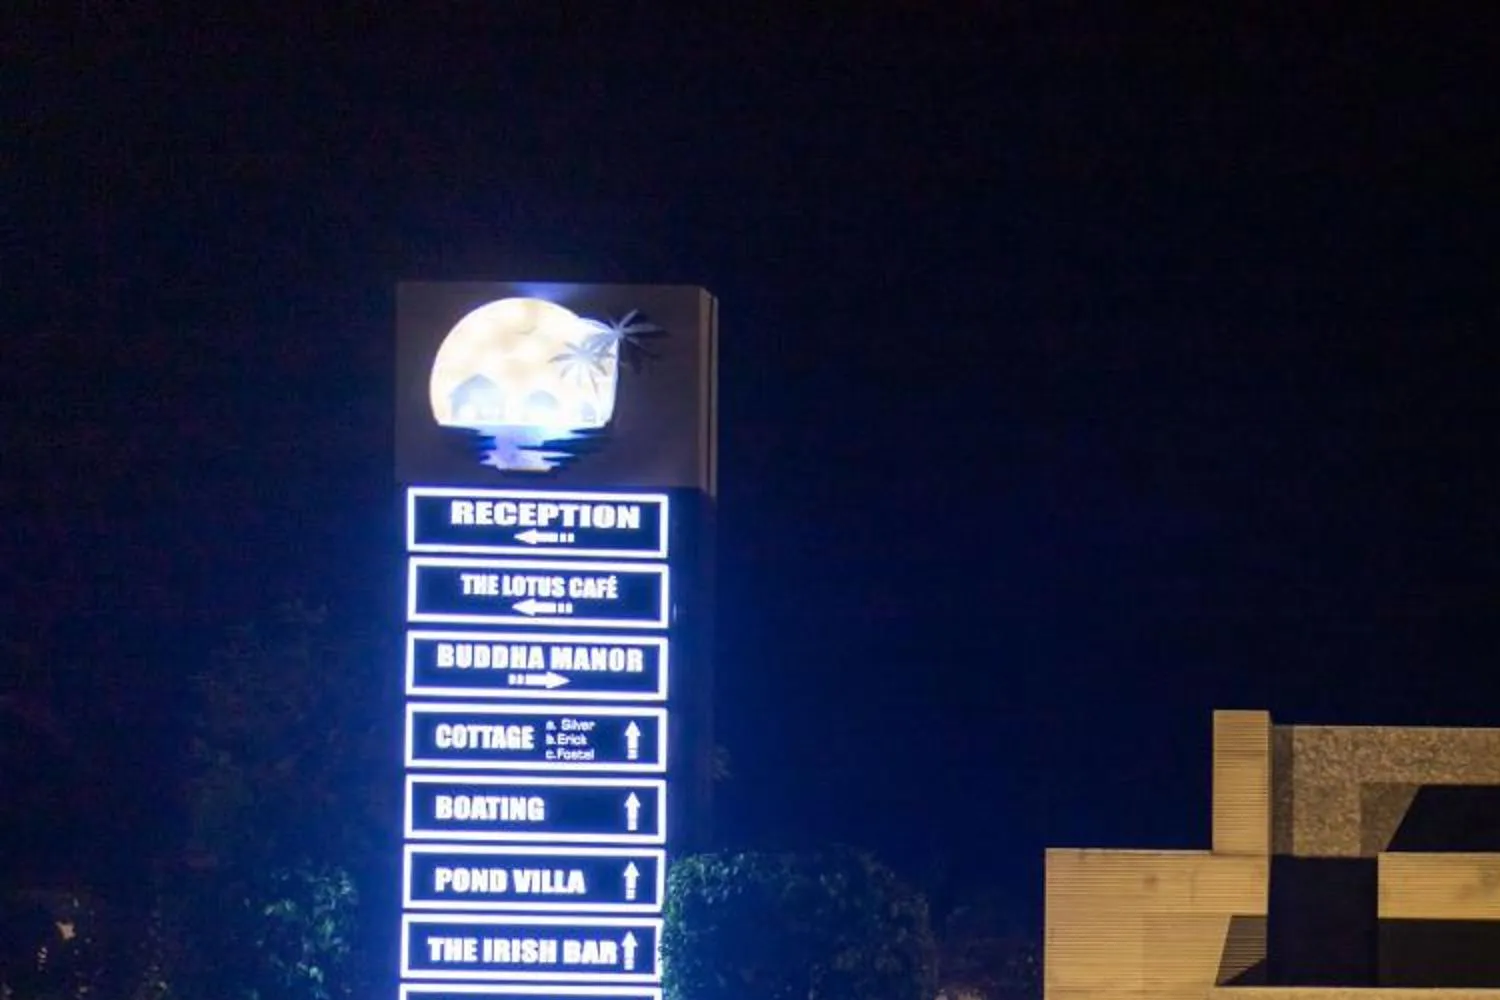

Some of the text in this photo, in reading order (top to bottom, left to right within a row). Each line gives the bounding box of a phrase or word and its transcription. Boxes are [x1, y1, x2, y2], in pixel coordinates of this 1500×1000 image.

[451, 500, 641, 529] RECEPTION
[461, 574, 619, 599] THE LOTUS CAFÉ
[437, 643, 644, 673] BUDDHA MANOR
[436, 724, 534, 750] COTTAGE
[435, 795, 544, 821] BOATING
[435, 867, 586, 894] POND VILLA
[428, 937, 618, 964] THE IRISH BAR
